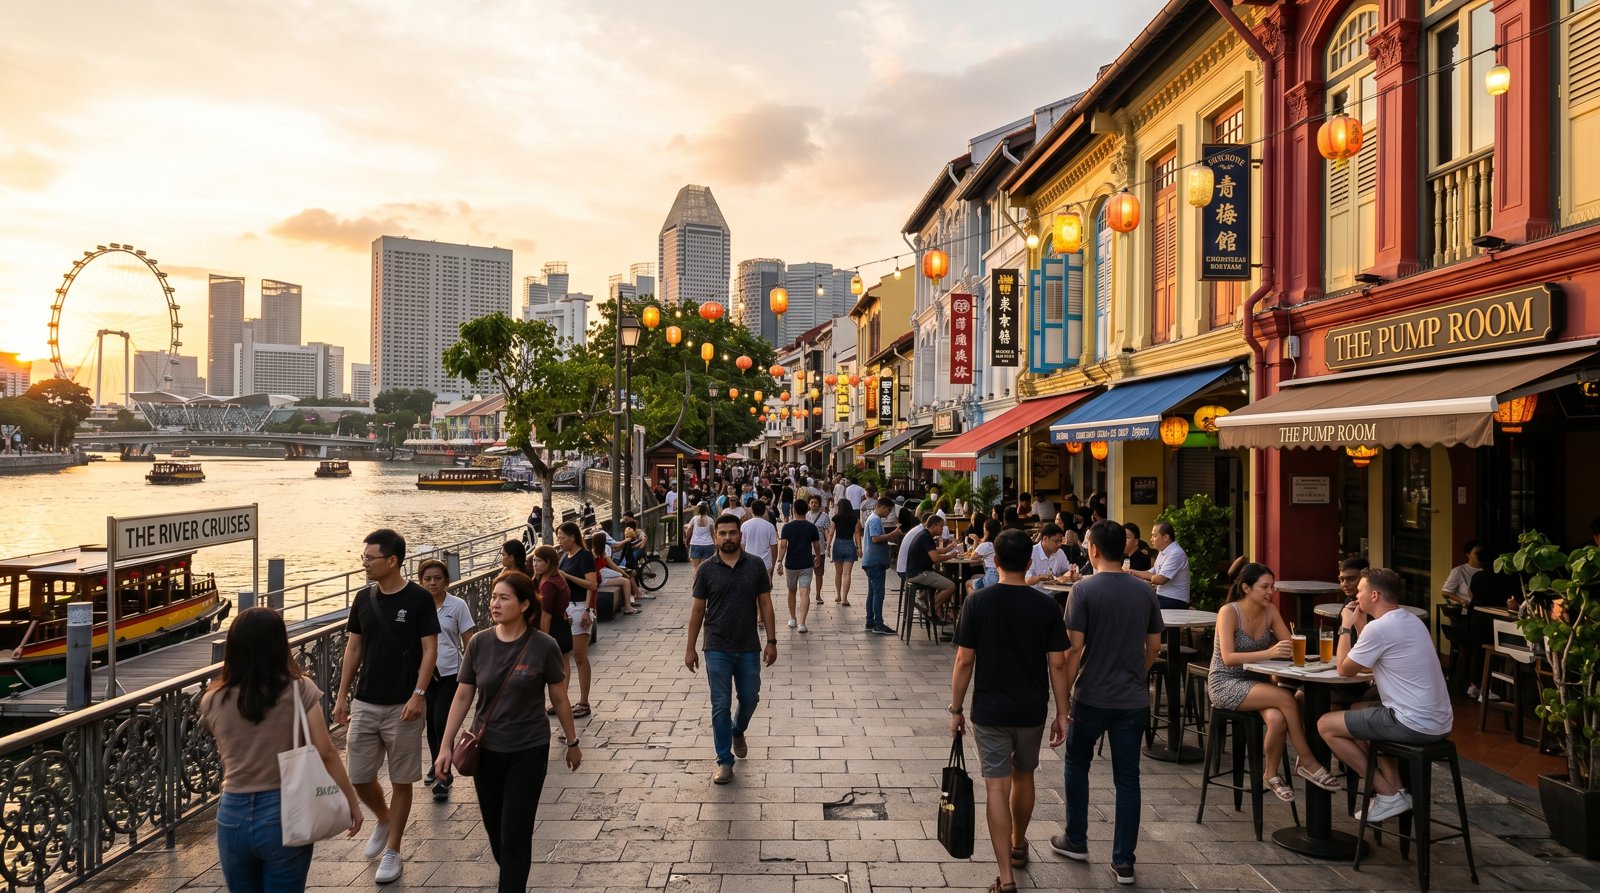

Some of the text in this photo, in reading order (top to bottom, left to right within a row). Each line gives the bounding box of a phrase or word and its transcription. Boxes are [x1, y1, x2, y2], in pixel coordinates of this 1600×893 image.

[1215, 174, 1238, 252] 青梅館
[1333, 297, 1533, 362] THE PUMP ROOM
[1279, 422, 1377, 443] THE PUMP ROOM
[125, 514, 249, 548] THE RIVER CRUISES
